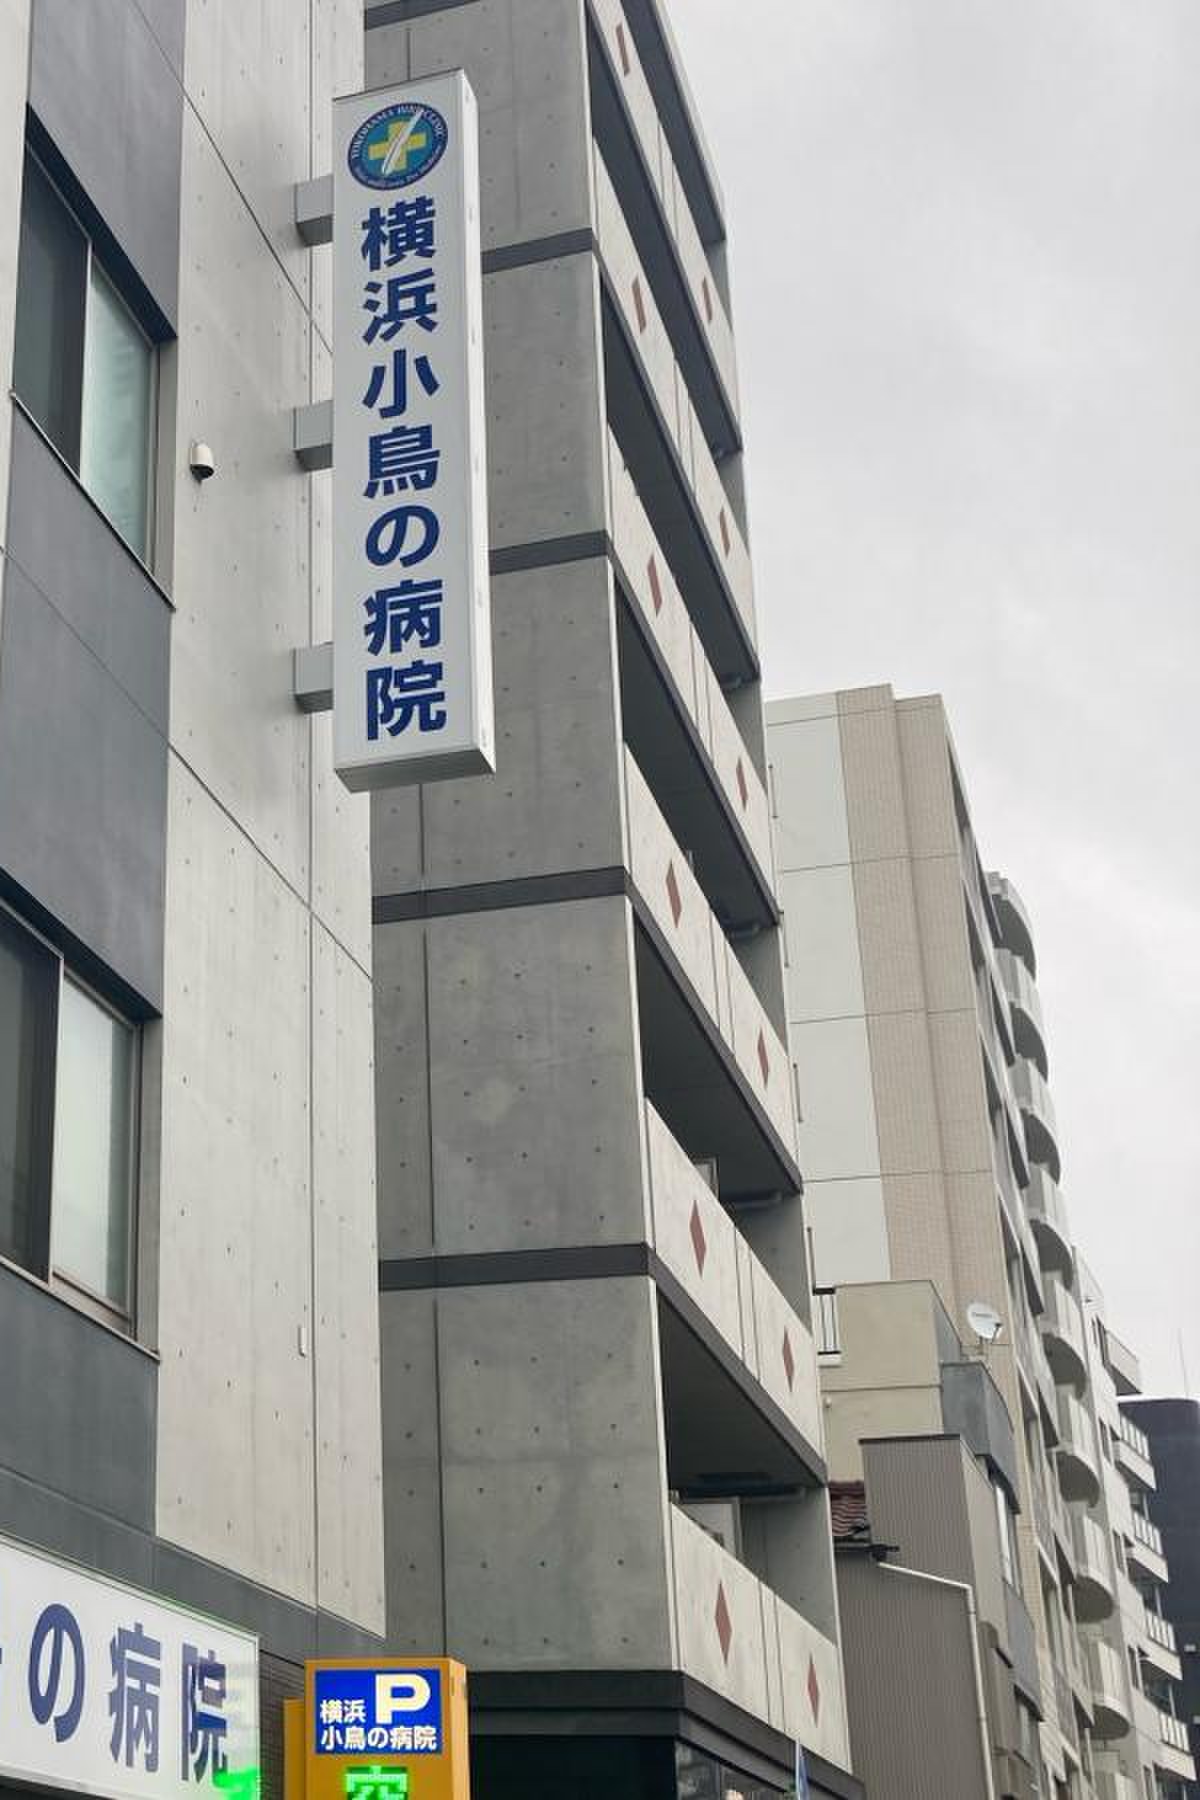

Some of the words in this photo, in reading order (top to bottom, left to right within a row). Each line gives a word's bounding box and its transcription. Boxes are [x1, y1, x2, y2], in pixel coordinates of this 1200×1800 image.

[361, 196, 447, 740] 横浜小鳥の病院
[320, 1699, 366, 1724] 横浜
[375, 1673, 431, 1724] P
[320, 1725, 437, 1750] 小鳥の病院
